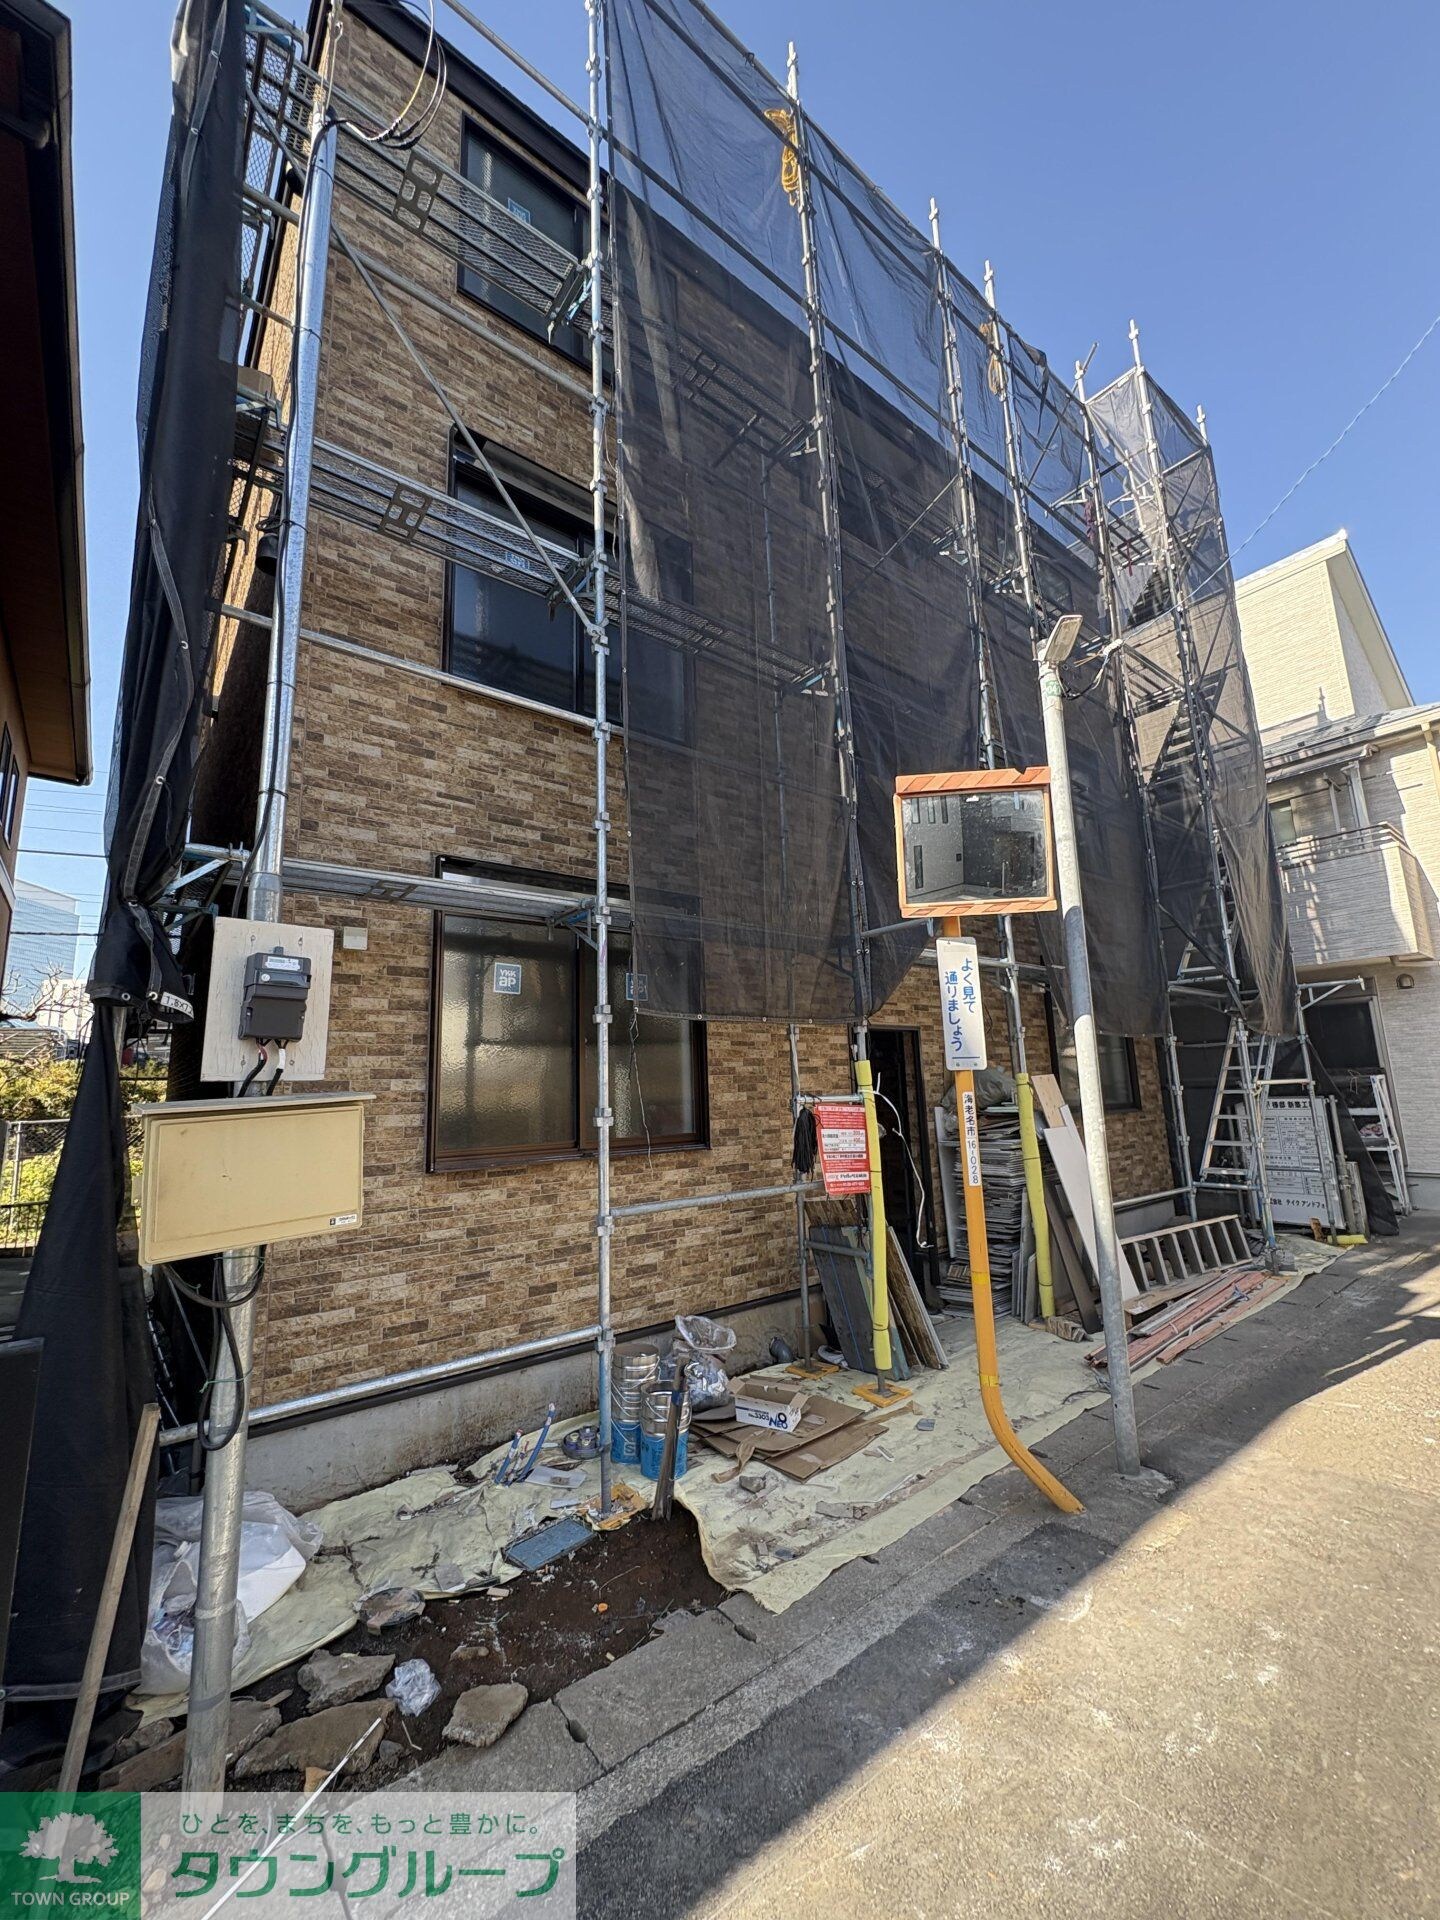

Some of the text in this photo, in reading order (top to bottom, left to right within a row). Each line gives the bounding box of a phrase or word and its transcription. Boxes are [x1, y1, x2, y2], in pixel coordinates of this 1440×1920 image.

[499, 976, 517, 988] ap
[944, 970, 963, 1052] 通りましょう
[961, 957, 976, 1014] よく見て
[964, 1094, 979, 1184] 海老名市 16-028
